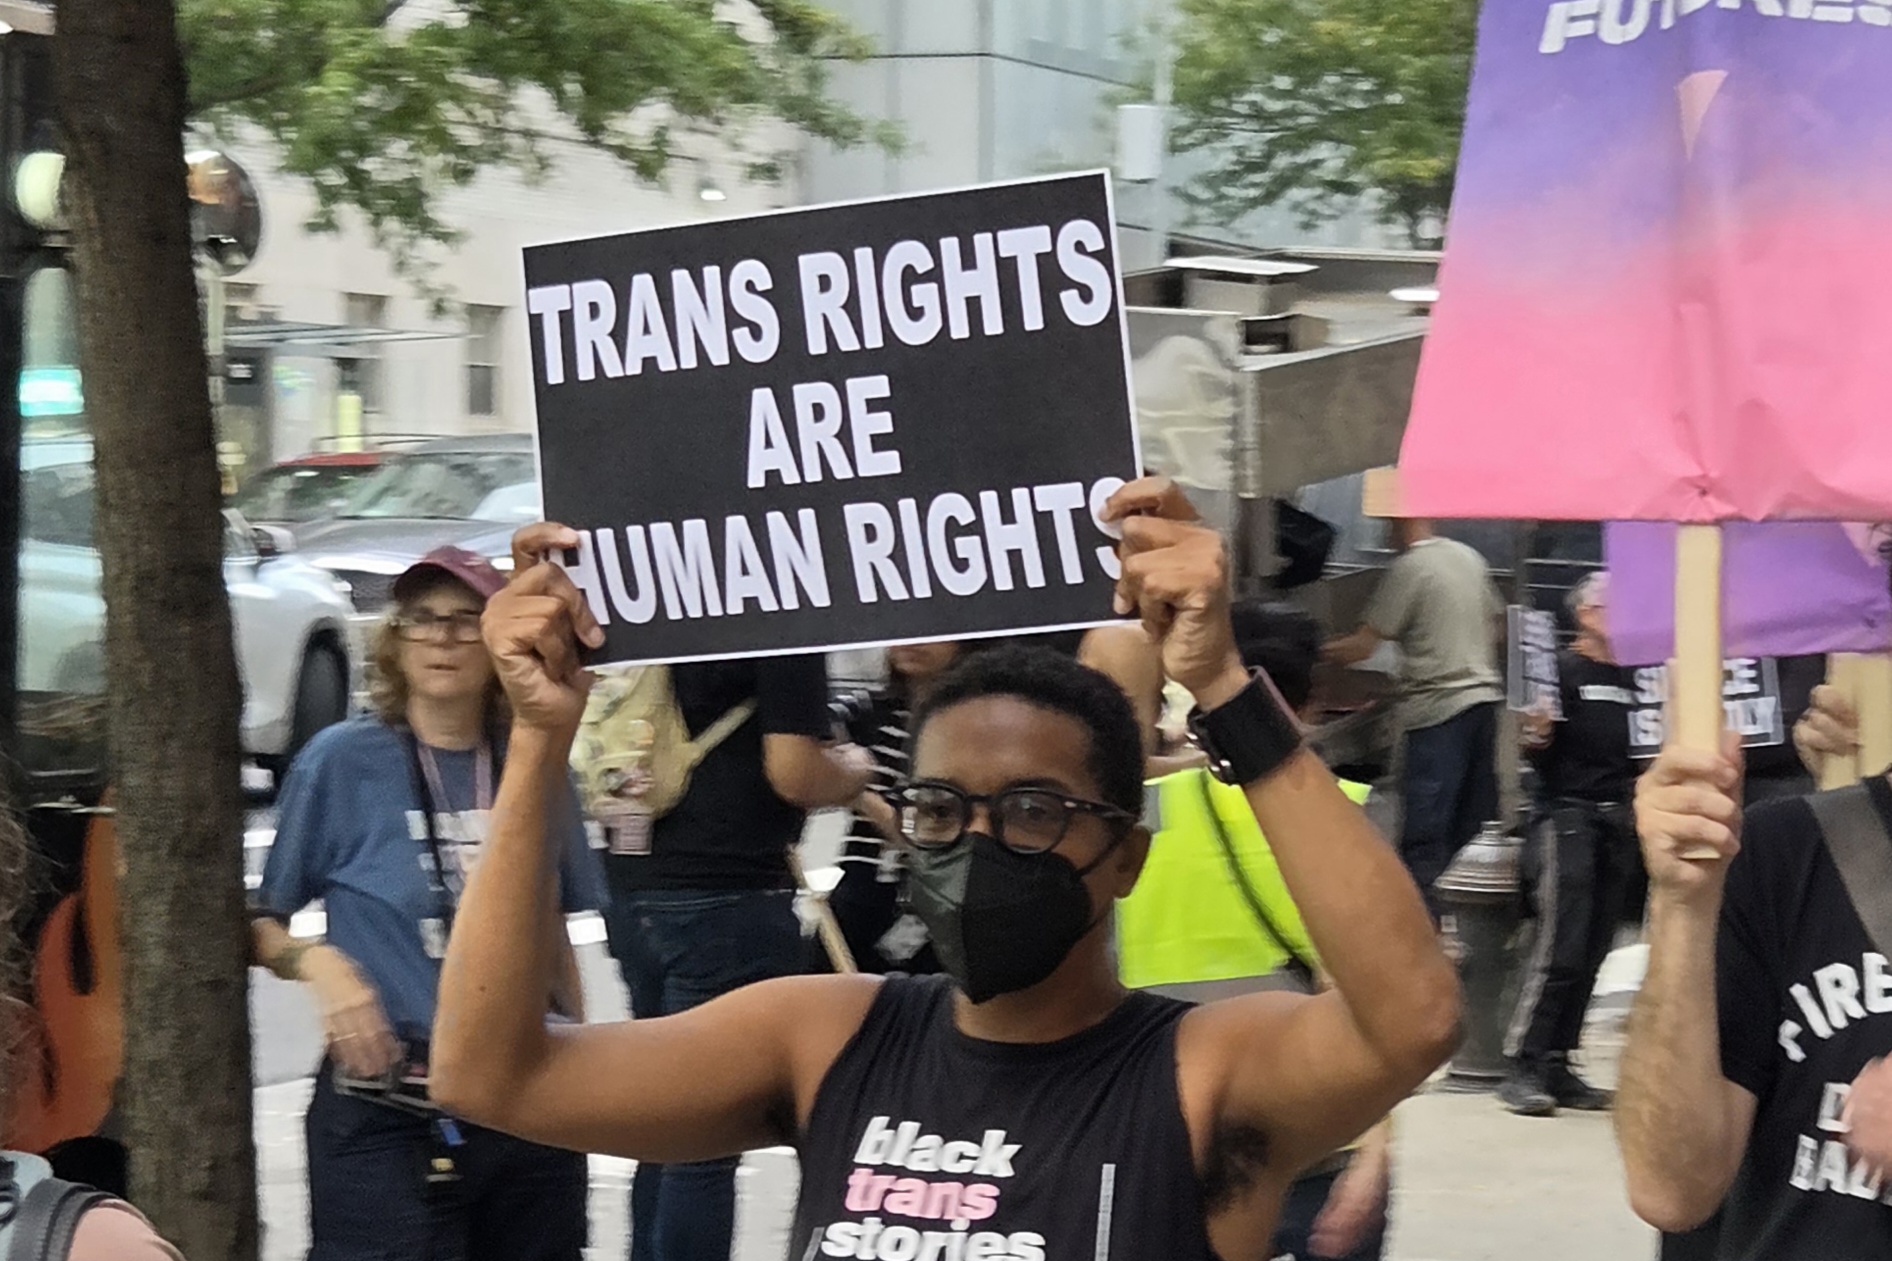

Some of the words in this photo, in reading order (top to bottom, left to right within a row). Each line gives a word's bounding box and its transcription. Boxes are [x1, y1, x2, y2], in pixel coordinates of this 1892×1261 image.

[528, 259, 781, 385] TRANS
[798, 219, 1112, 355] RIGHTS
[747, 374, 902, 488] ARE
[550, 507, 832, 626] HUMAN
[843, 477, 1126, 604] RIGHTS
[844, 1168, 999, 1220] trans
[853, 1116, 1022, 1178] black
